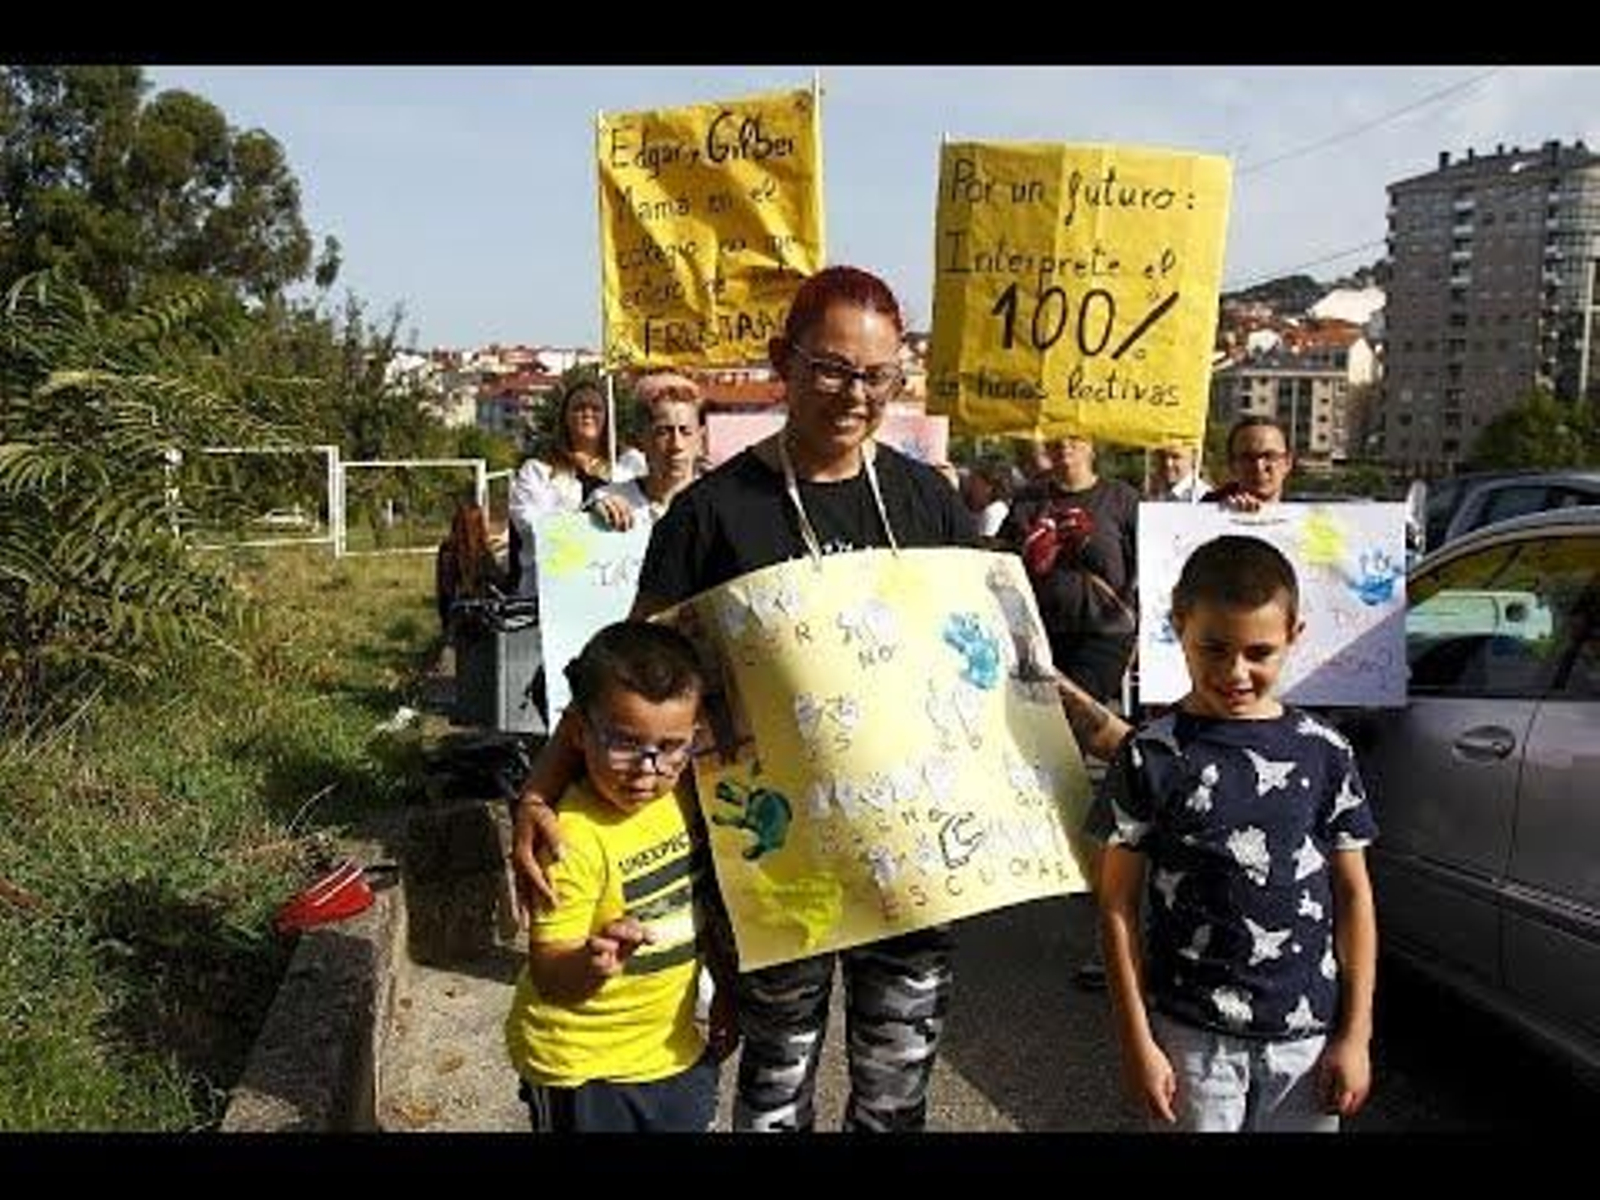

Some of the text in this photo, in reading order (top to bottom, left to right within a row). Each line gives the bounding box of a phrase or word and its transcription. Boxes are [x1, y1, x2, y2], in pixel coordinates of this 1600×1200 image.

[951, 158, 995, 203] Por
[1012, 178, 1045, 204] un
[1143, 248, 1177, 279] el
[1067, 365, 1181, 407] lectivas
